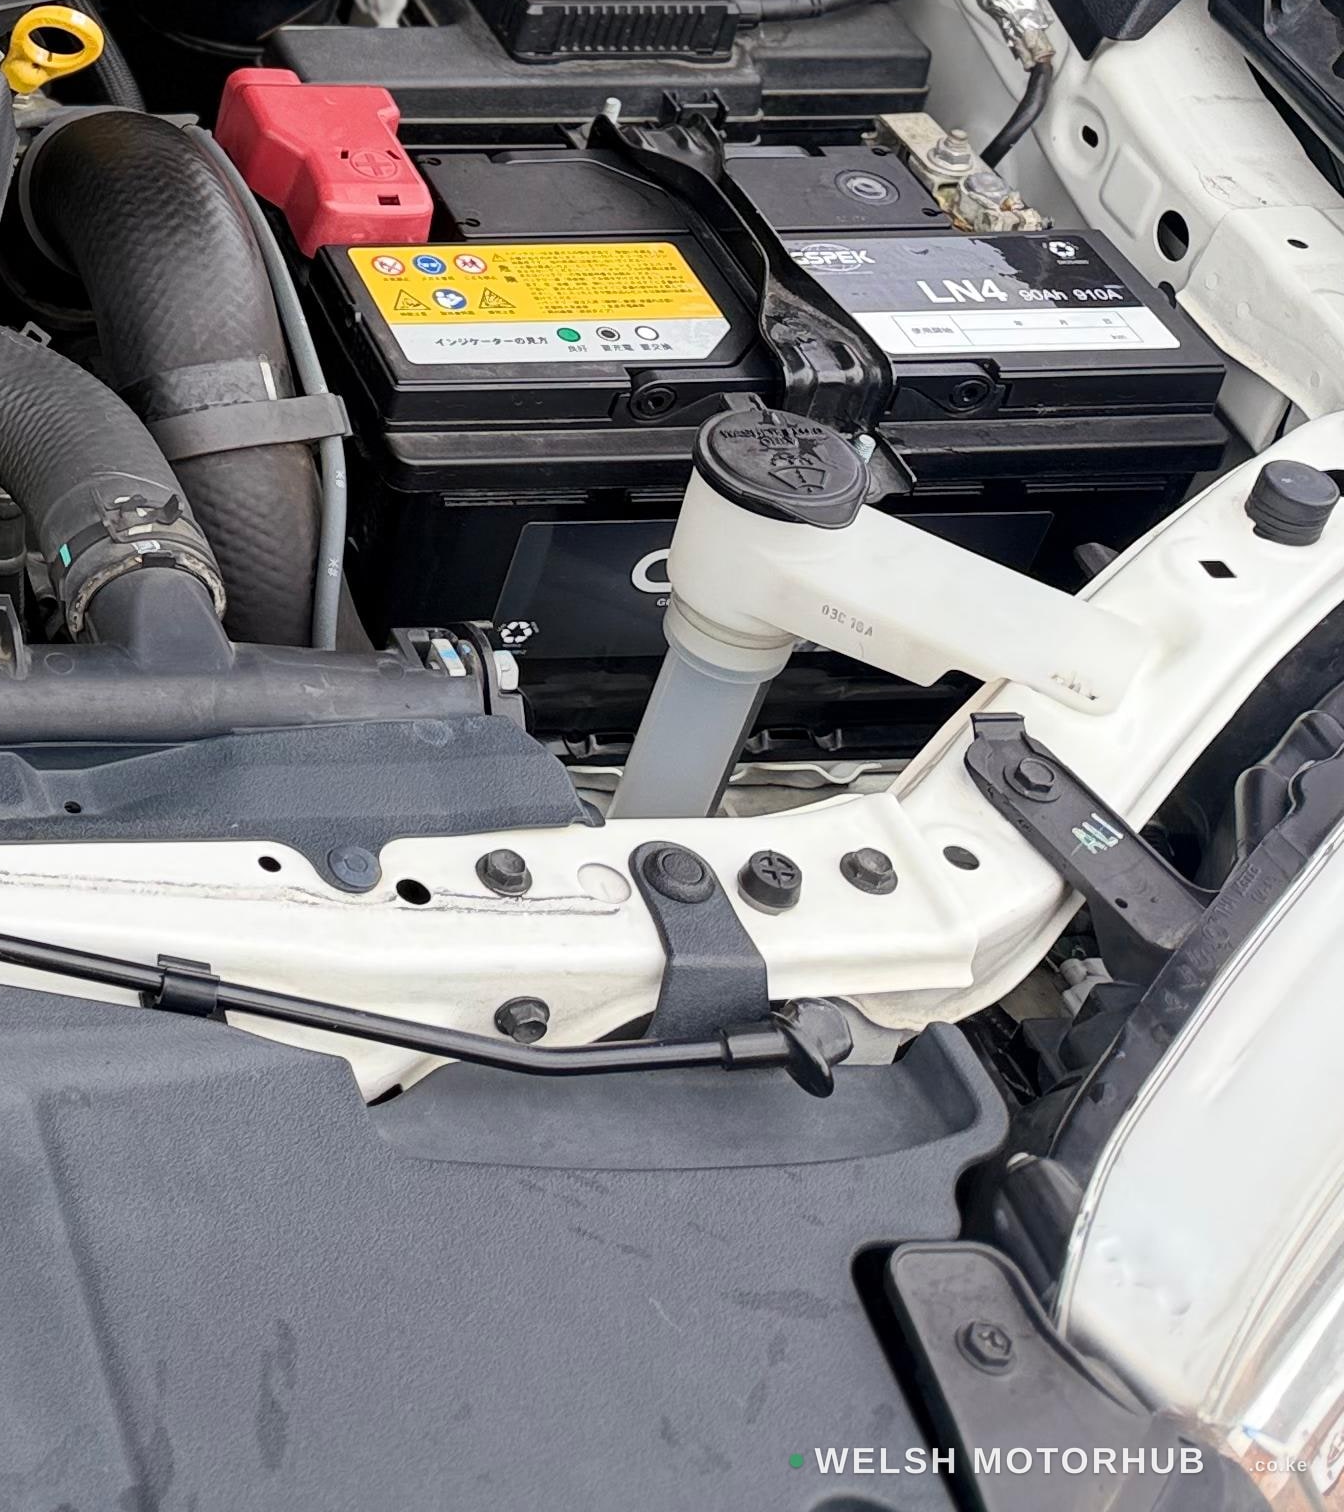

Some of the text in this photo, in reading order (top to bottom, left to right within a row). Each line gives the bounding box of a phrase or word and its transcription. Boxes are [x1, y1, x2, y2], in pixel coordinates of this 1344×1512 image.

[915, 278, 1124, 304] LN4 90Ah 910A
